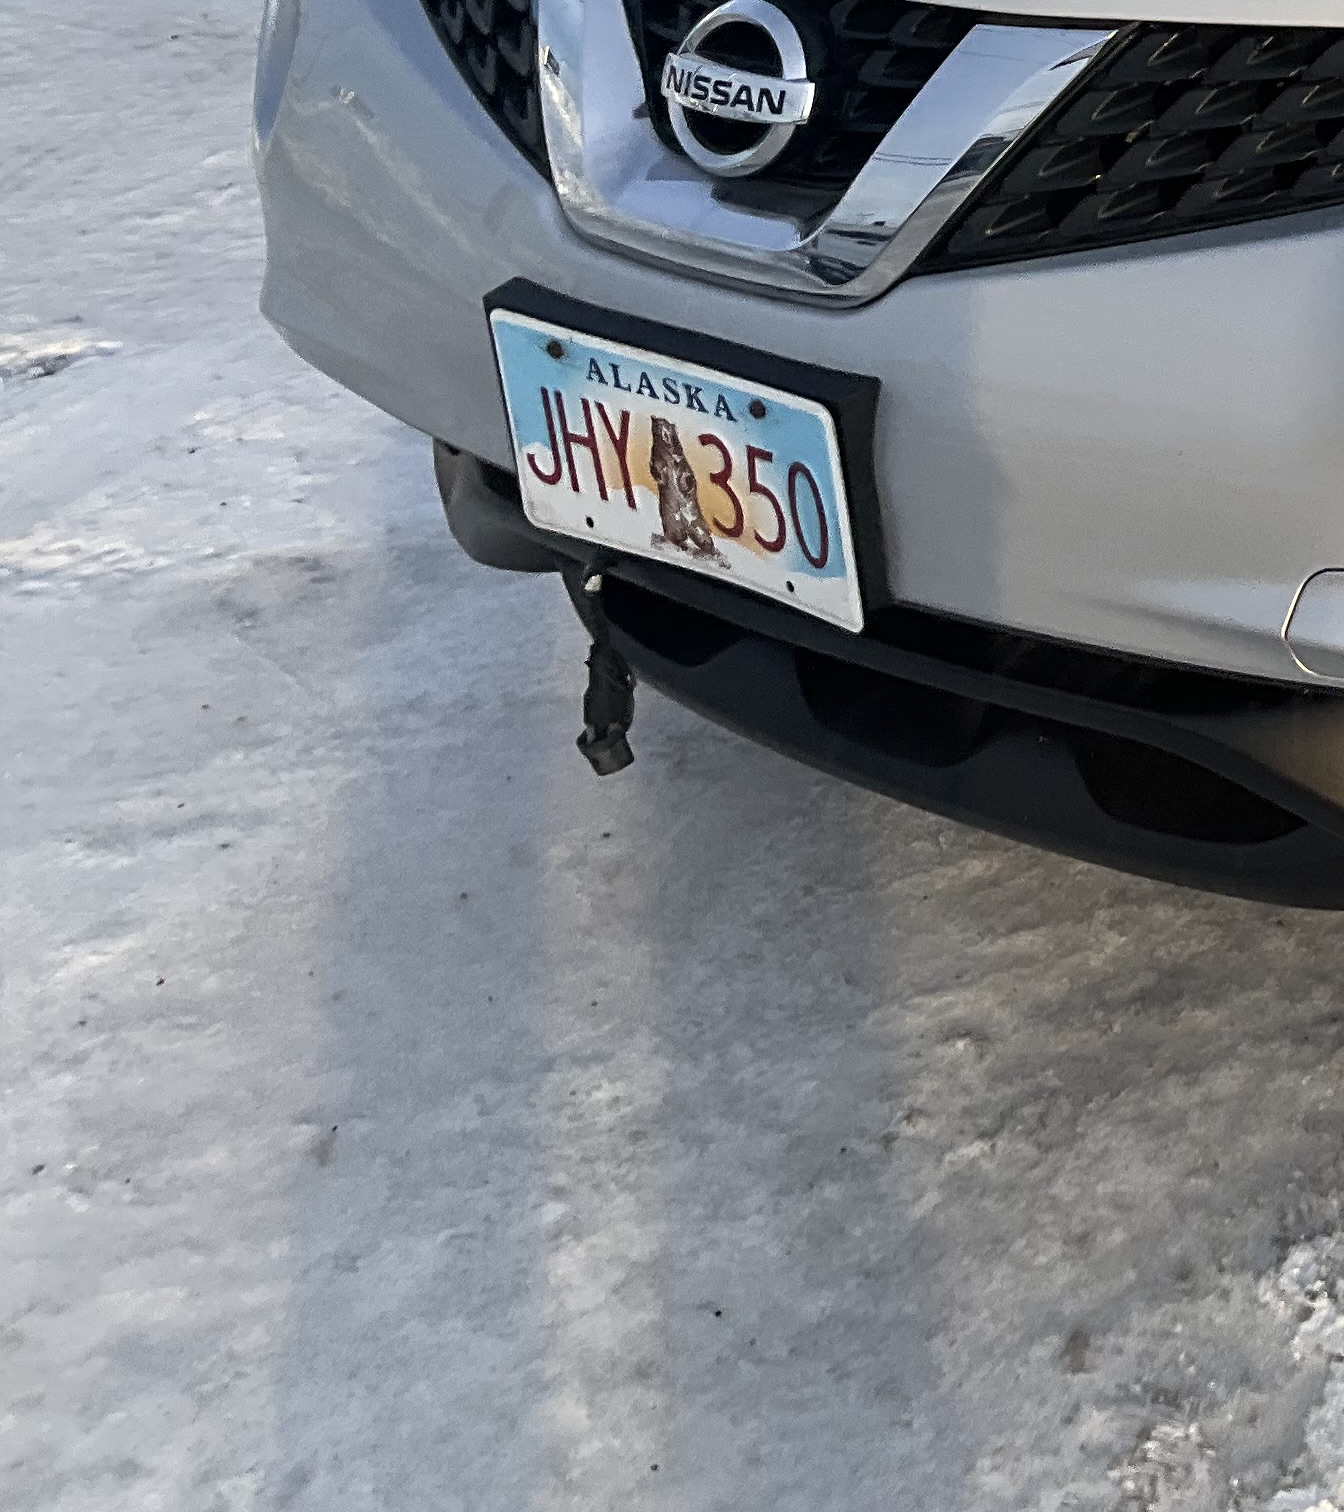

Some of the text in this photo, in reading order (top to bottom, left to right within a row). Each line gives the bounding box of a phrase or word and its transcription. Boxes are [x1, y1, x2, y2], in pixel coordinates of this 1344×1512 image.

[666, 65, 786, 115] NISSAN
[586, 357, 739, 422] ALASKA
[527, 385, 829, 569] JHY 350
